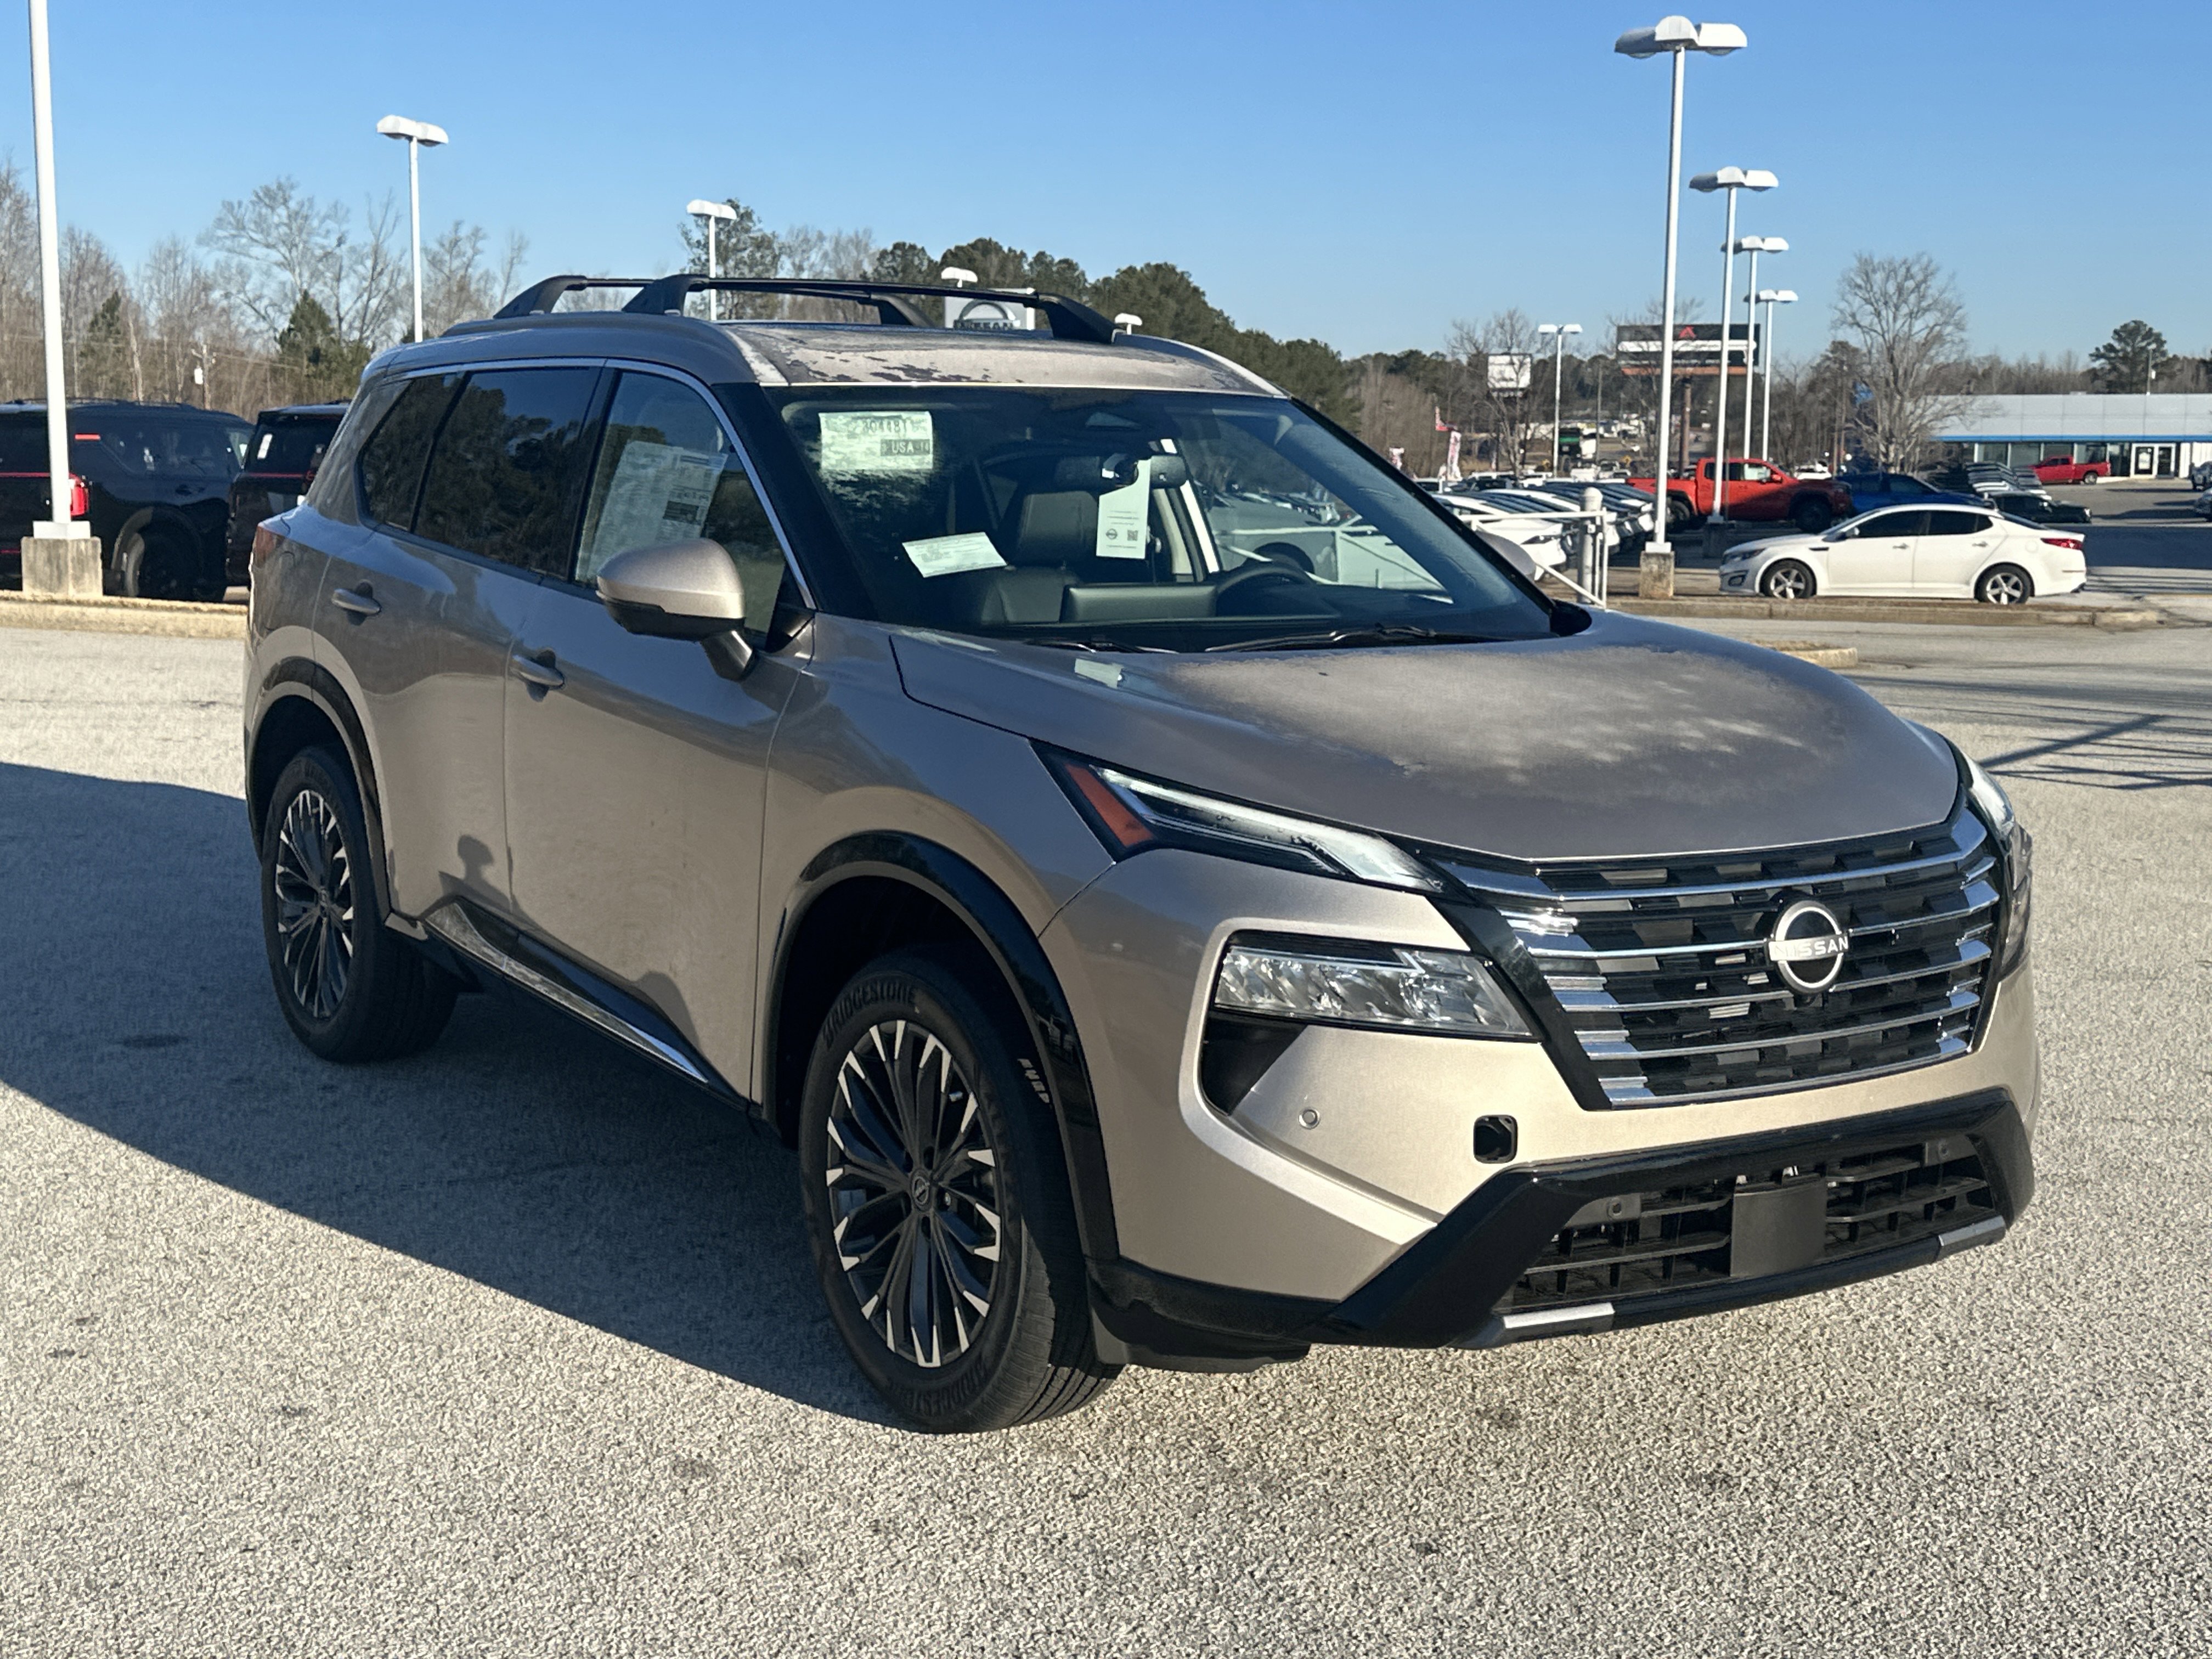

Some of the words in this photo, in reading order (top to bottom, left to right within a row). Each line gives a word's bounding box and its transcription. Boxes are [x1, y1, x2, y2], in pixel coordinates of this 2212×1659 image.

[891, 441, 915, 453] USA
[1773, 935, 1849, 958] NISSAN
[822, 979, 915, 1049] BRIDGESTONE
